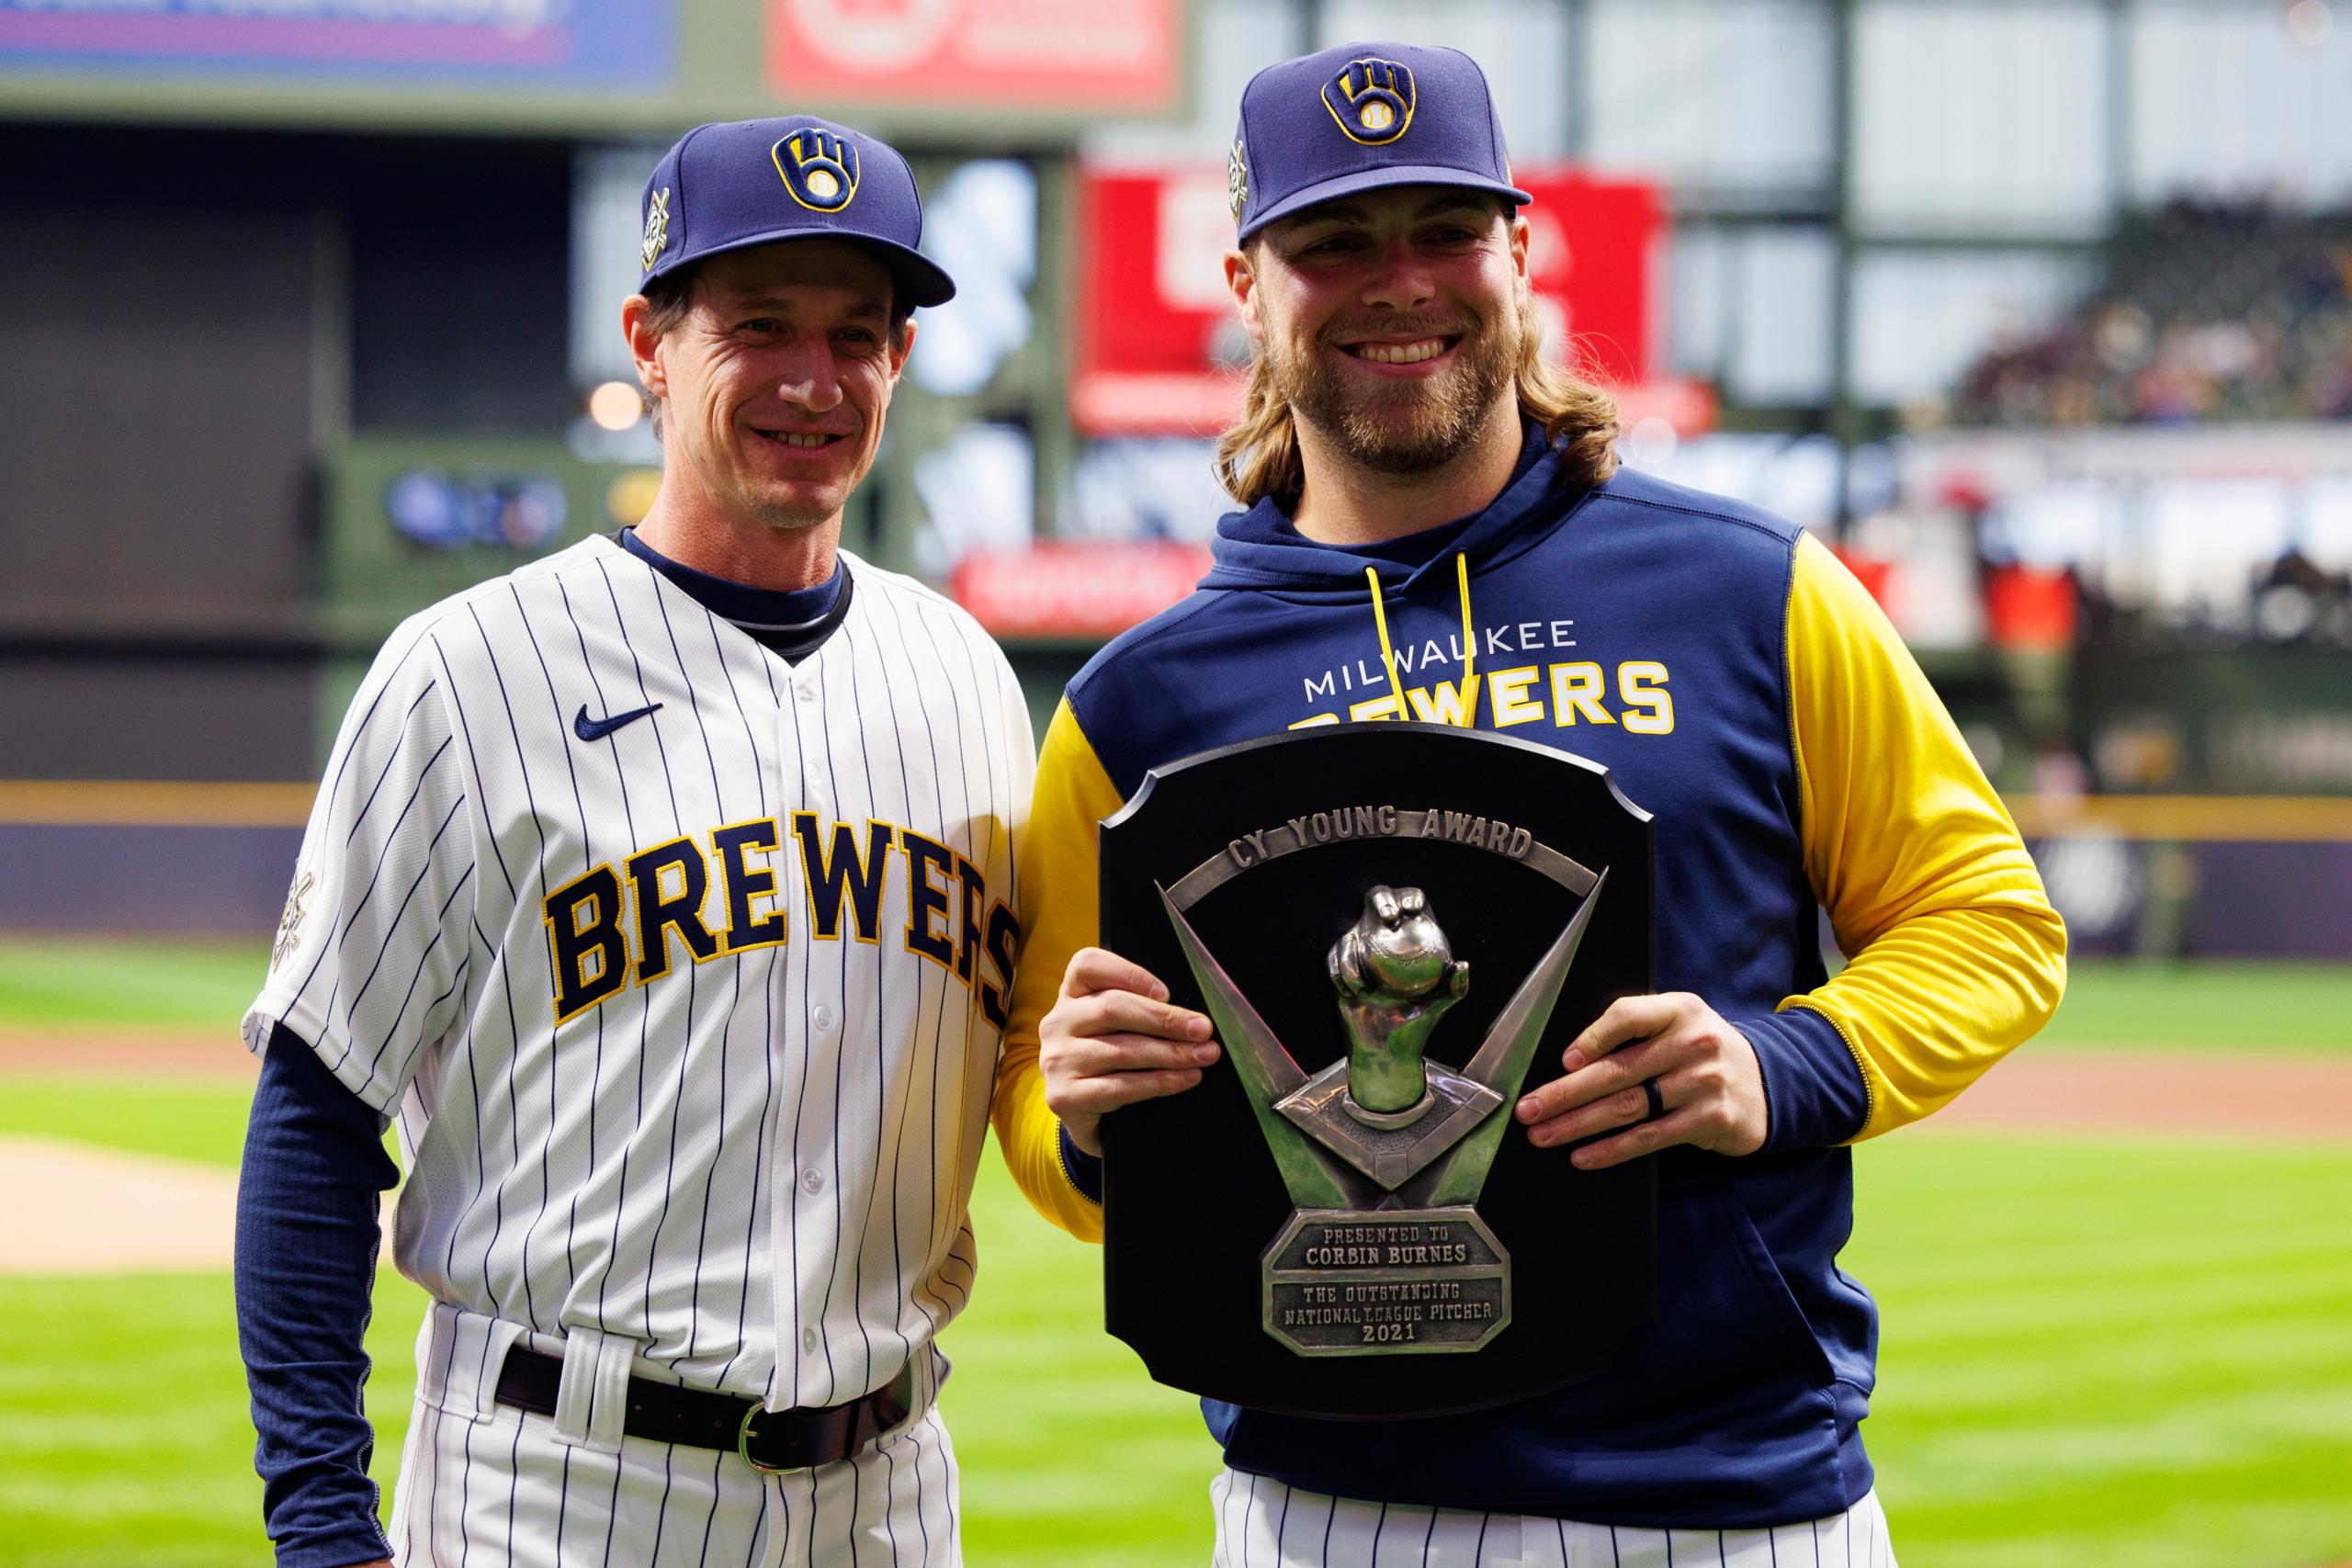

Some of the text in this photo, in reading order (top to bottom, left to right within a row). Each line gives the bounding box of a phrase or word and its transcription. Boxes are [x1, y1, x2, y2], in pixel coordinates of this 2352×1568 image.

[1303, 619, 1577, 704] MILWAUKEE
[1227, 805, 1532, 868] CY YOUNG AWARD
[543, 810, 1021, 1030] BREWERS
[1324, 1225, 1449, 1245] PRESENTED TO
[1306, 1244, 1467, 1266] CORBIN BURNES
[1303, 1282, 1461, 1303] THE OUTSTANDING
[1285, 1302, 1493, 1325] NATIONAL LEAGUE PITCHER
[1363, 1323, 1416, 1343] 2021
